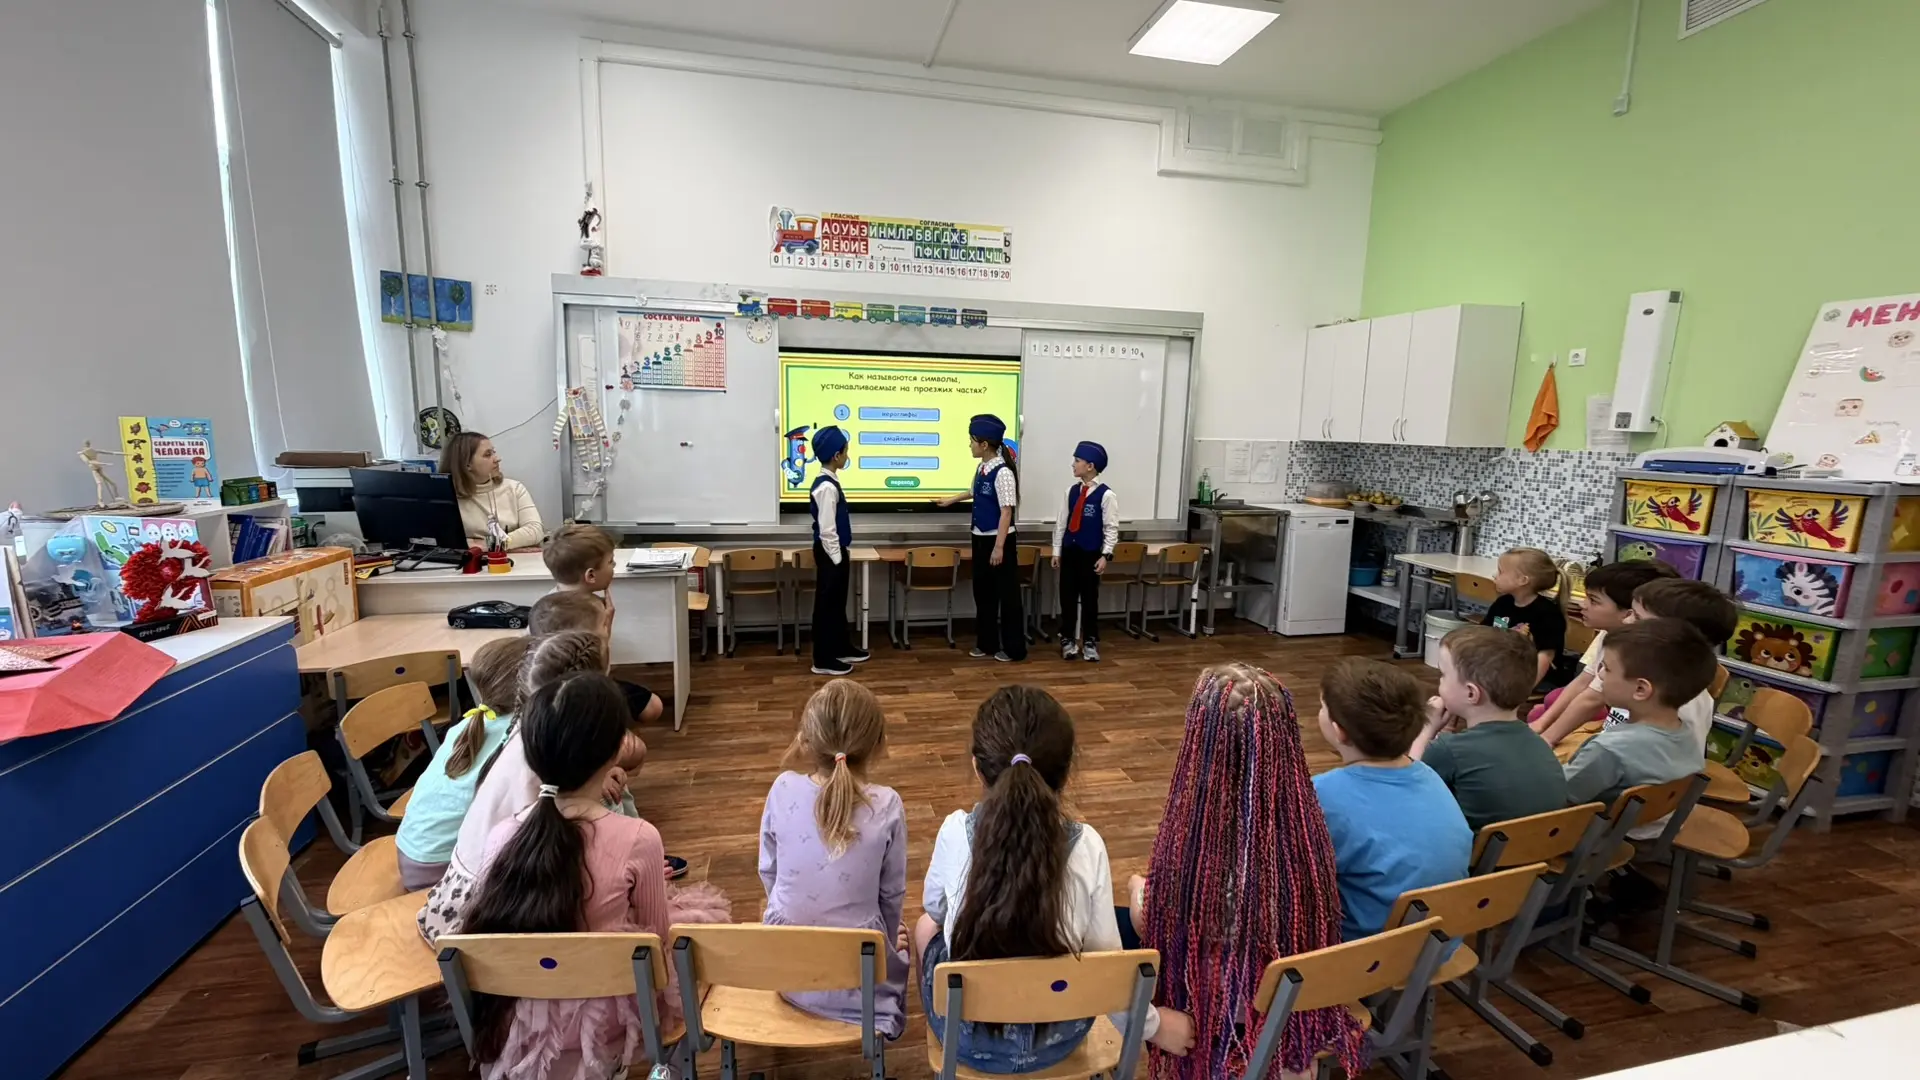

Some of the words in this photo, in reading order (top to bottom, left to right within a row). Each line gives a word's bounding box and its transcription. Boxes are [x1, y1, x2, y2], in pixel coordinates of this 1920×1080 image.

[830, 212, 860, 220] ГЛАСНЫЕ
[919, 220, 956, 228] СОГЛАСНЫЕ
[774, 255, 779, 263] 0
[786, 256, 791, 265] 1
[798, 257, 804, 265] 2
[810, 258, 815, 266] 3
[821, 258, 827, 267] 4
[834, 259, 839, 267] 5
[845, 260, 851, 268] 6
[857, 261, 862, 269] 7
[868, 262, 874, 270] 8
[880, 262, 886, 271] 9
[890, 263, 899, 272] 10
[902, 264, 910, 272] 11
[913, 265, 922, 273] 12
[924, 265, 933, 274] 13
[935, 266, 944, 274] 14
[946, 267, 955, 275] 15
[957, 268, 966, 276] 16
[968, 268, 978, 277] 17
[979, 269, 988, 277] 18
[990, 270, 999, 278] 19
[1001, 271, 1010, 279] 20
[643, 313, 672, 321] СОСТАВ
[672, 315, 701, 323] ЧИСЛА
[644, 357, 650, 366] 3
[664, 347, 670, 356] 5
[674, 343, 681, 352] 6
[695, 334, 702, 343] 8
[706, 331, 713, 340] 9
[714, 328, 724, 336] 10
[1055, 345, 1060, 353] 3
[1089, 345, 1094, 353] 6
[1110, 346, 1115, 354] 8
[848, 372, 864, 380] Как
[867, 374, 917, 382] называются
[920, 376, 961, 384] символы,
[820, 383, 897, 391] устанавливаемые
[914, 386, 953, 394] проезжих
[155, 447, 205, 456] ЧЕЛОВЕКА
